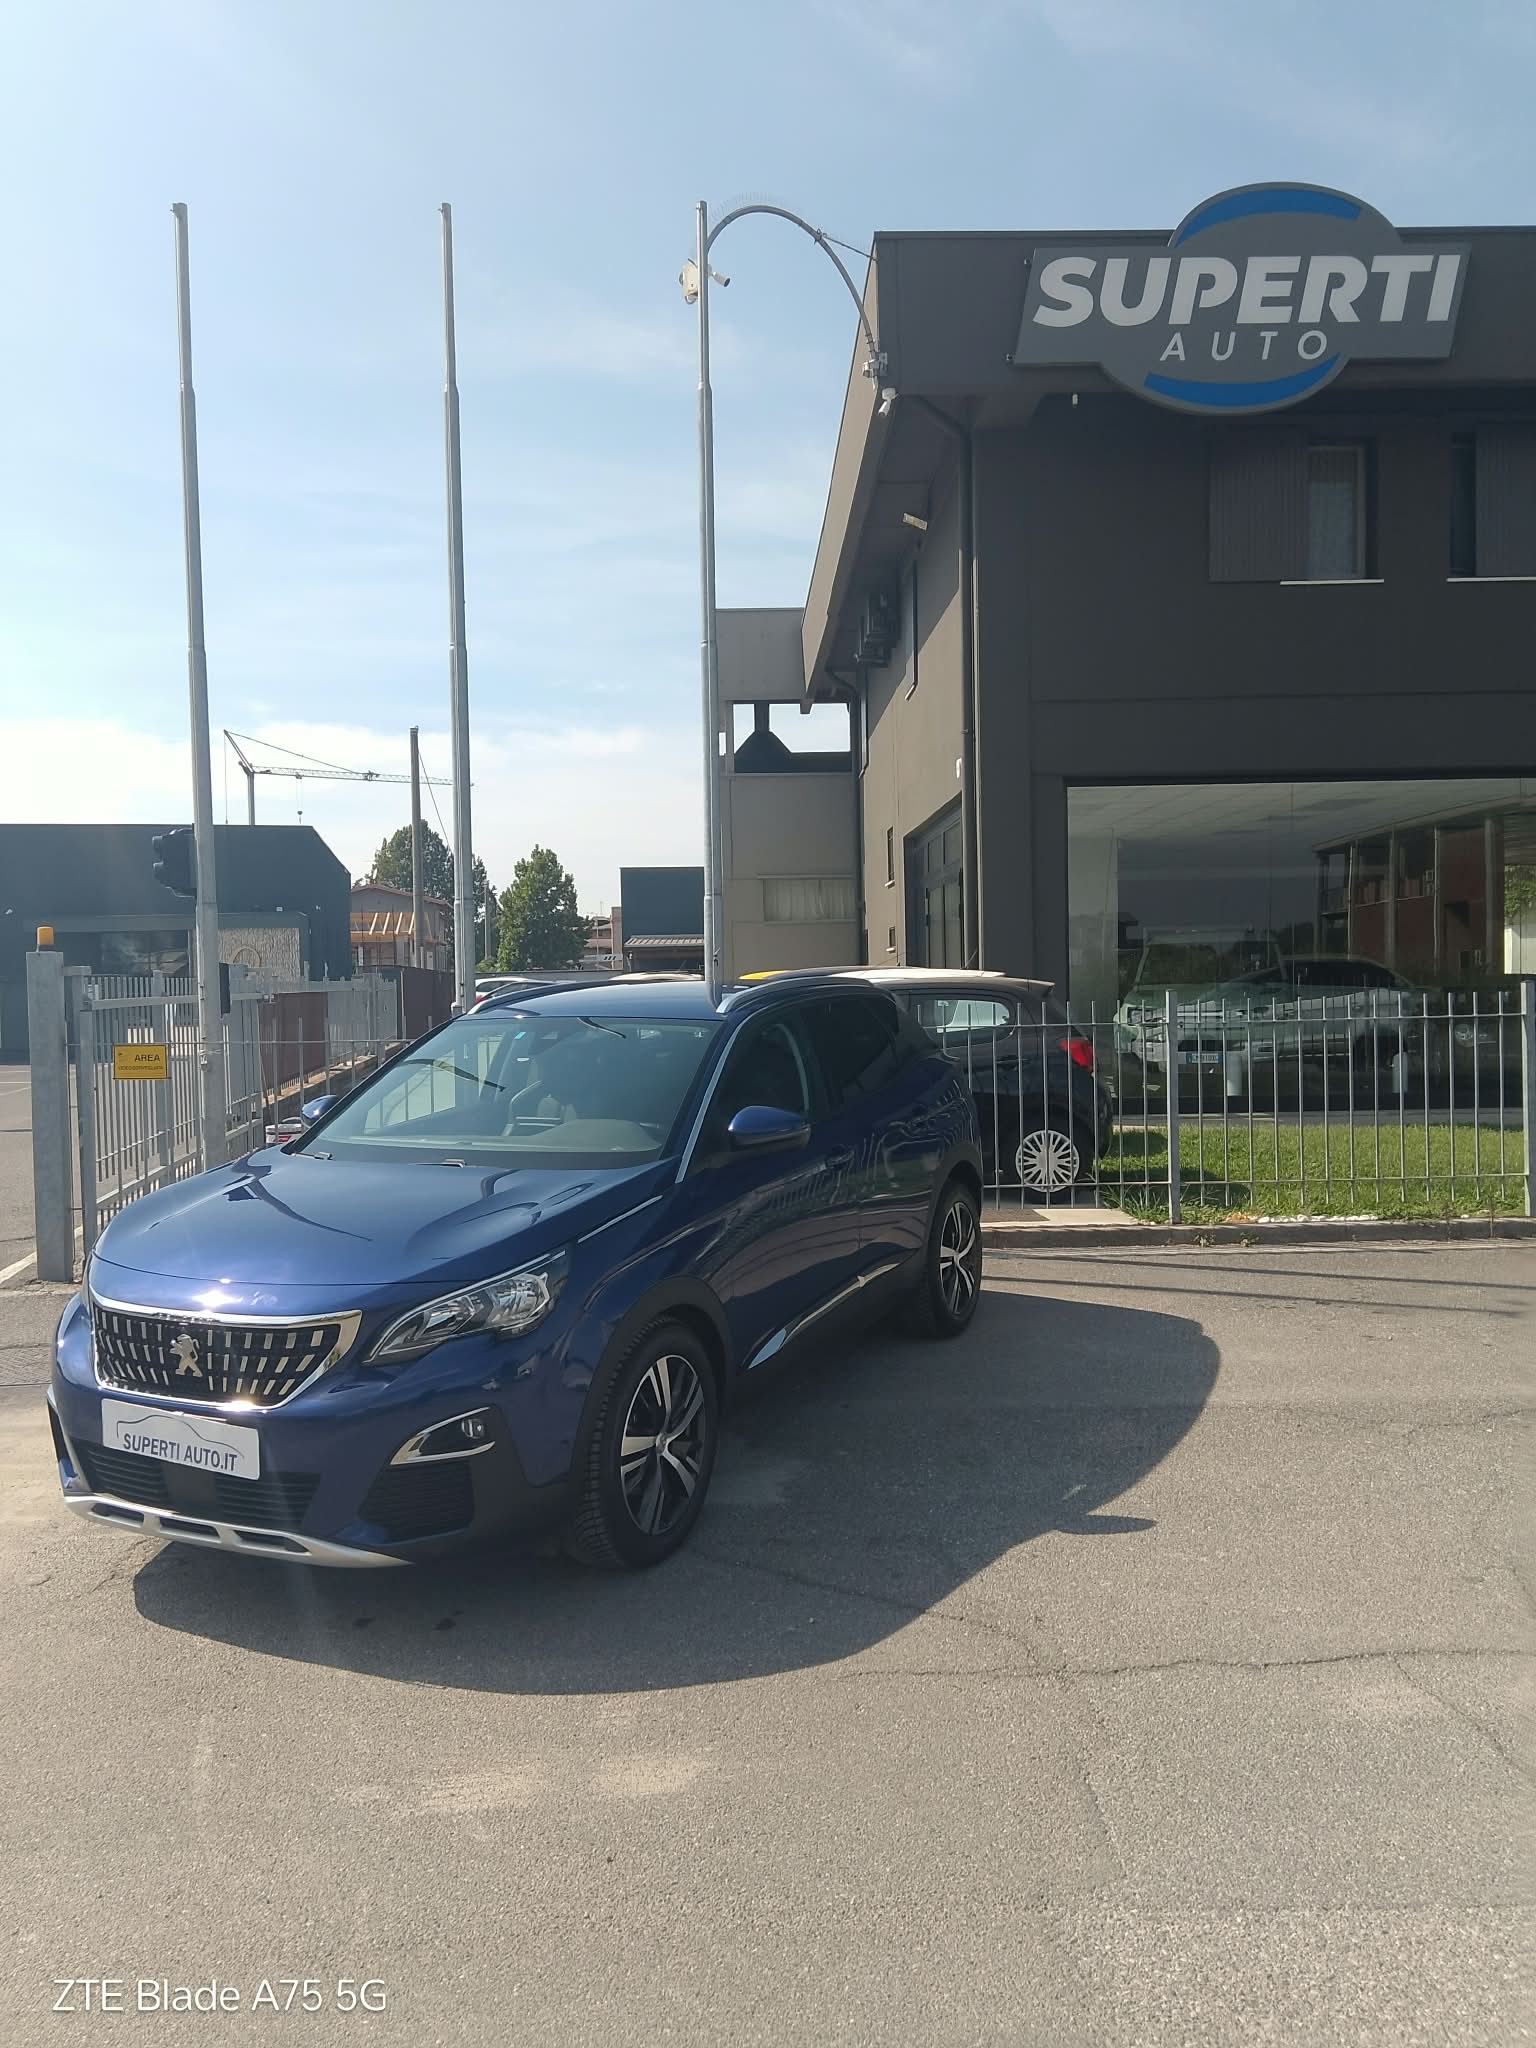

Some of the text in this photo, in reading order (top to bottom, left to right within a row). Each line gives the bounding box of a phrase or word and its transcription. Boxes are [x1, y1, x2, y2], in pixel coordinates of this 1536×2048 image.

[1033, 254, 1461, 328] SUPERTI
[1160, 330, 1328, 361] AUTO
[134, 1054, 161, 1062] AREA
[123, 1433, 238, 1471] SUPERTI AUTO.IT
